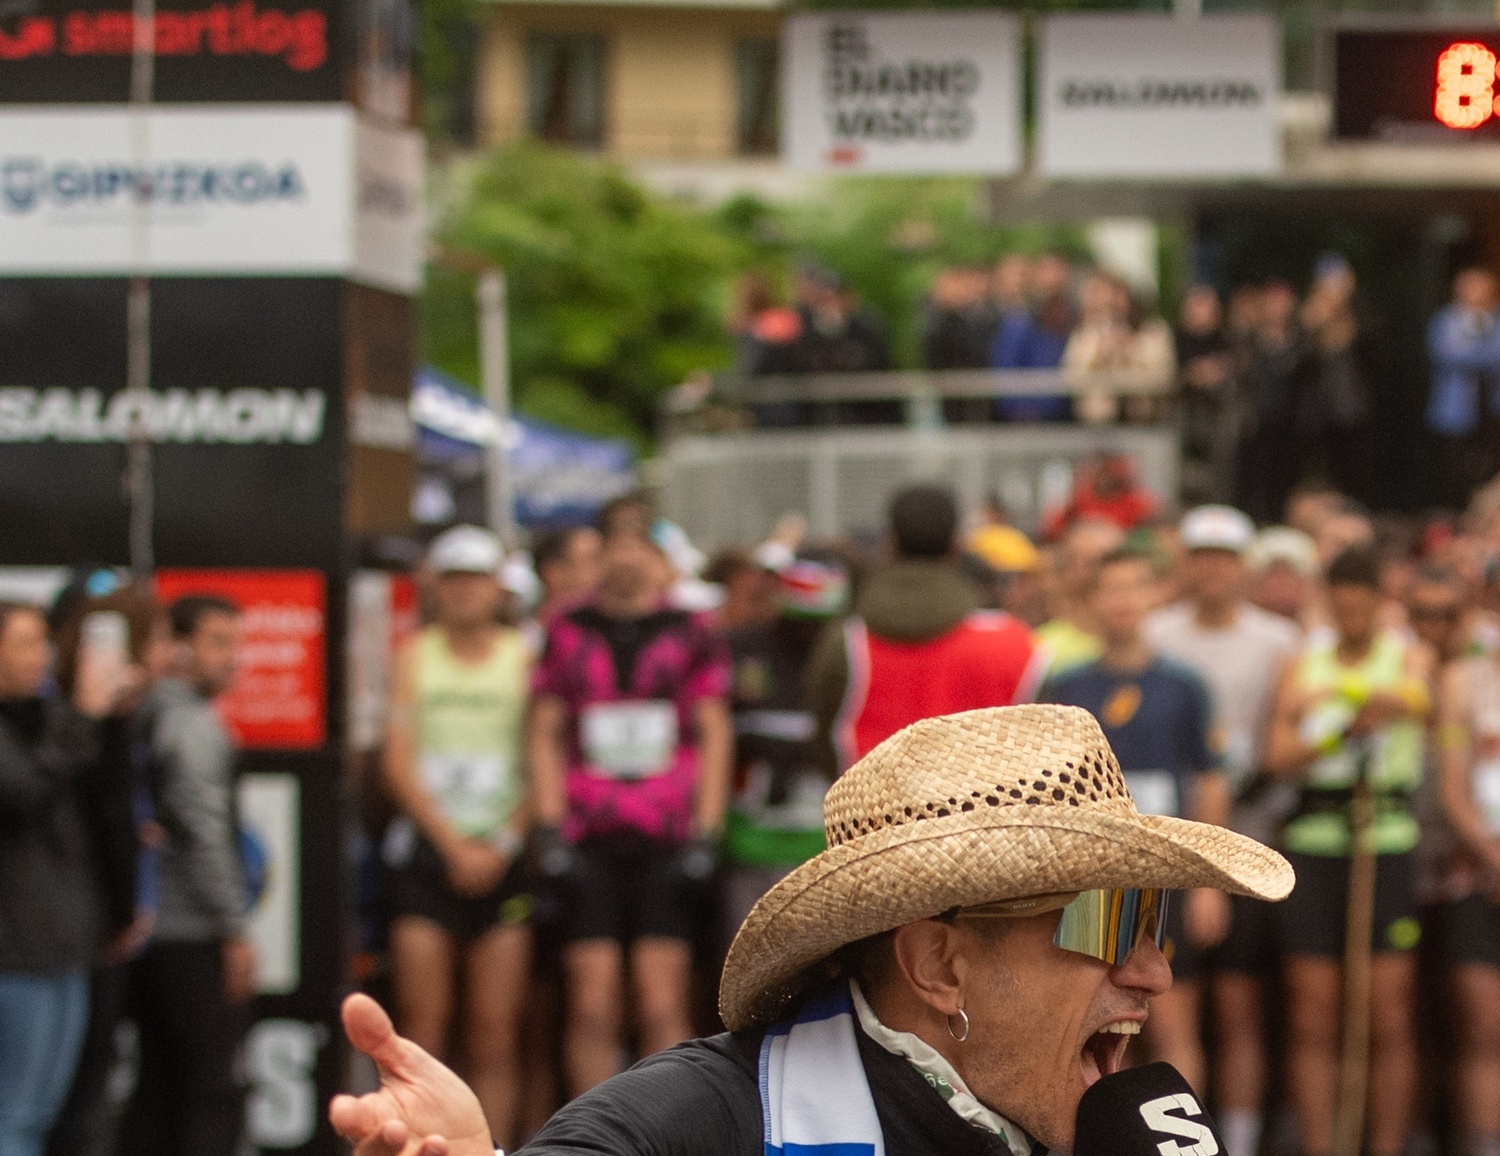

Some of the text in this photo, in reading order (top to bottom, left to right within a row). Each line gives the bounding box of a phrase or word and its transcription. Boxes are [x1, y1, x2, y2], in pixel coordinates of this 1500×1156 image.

[824, 61, 980, 100] DIARIO
[826, 104, 975, 143] VASCO
[0, 388, 327, 444] SALOMON
